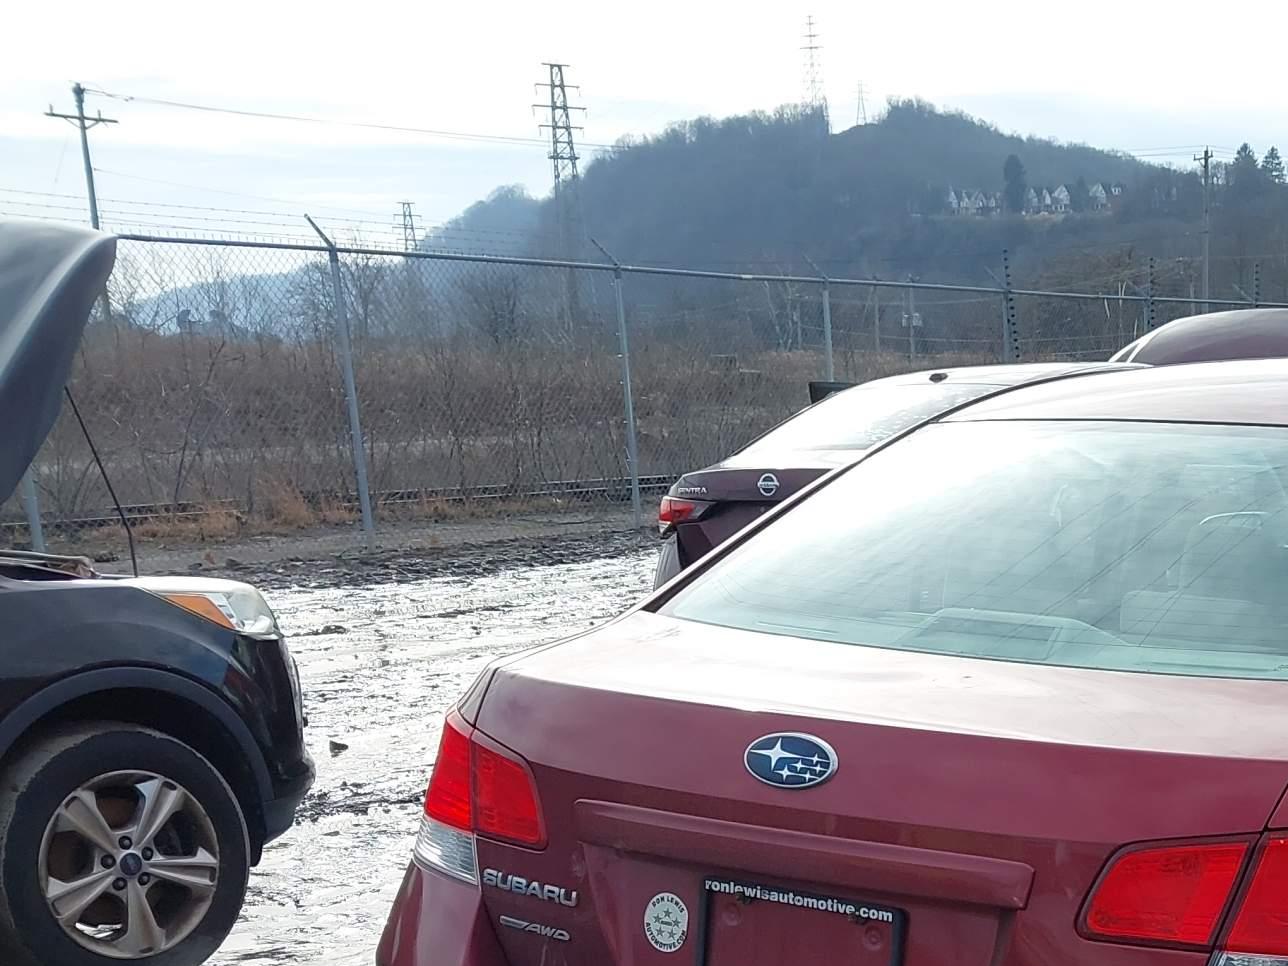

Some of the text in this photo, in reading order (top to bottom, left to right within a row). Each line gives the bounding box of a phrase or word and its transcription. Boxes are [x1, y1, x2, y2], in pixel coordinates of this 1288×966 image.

[483, 868, 577, 907] SUBARU
[704, 879, 893, 922] ronlewisautomotive.com
[666, 896, 685, 913] LEWIS
[524, 923, 571, 941] AWD
